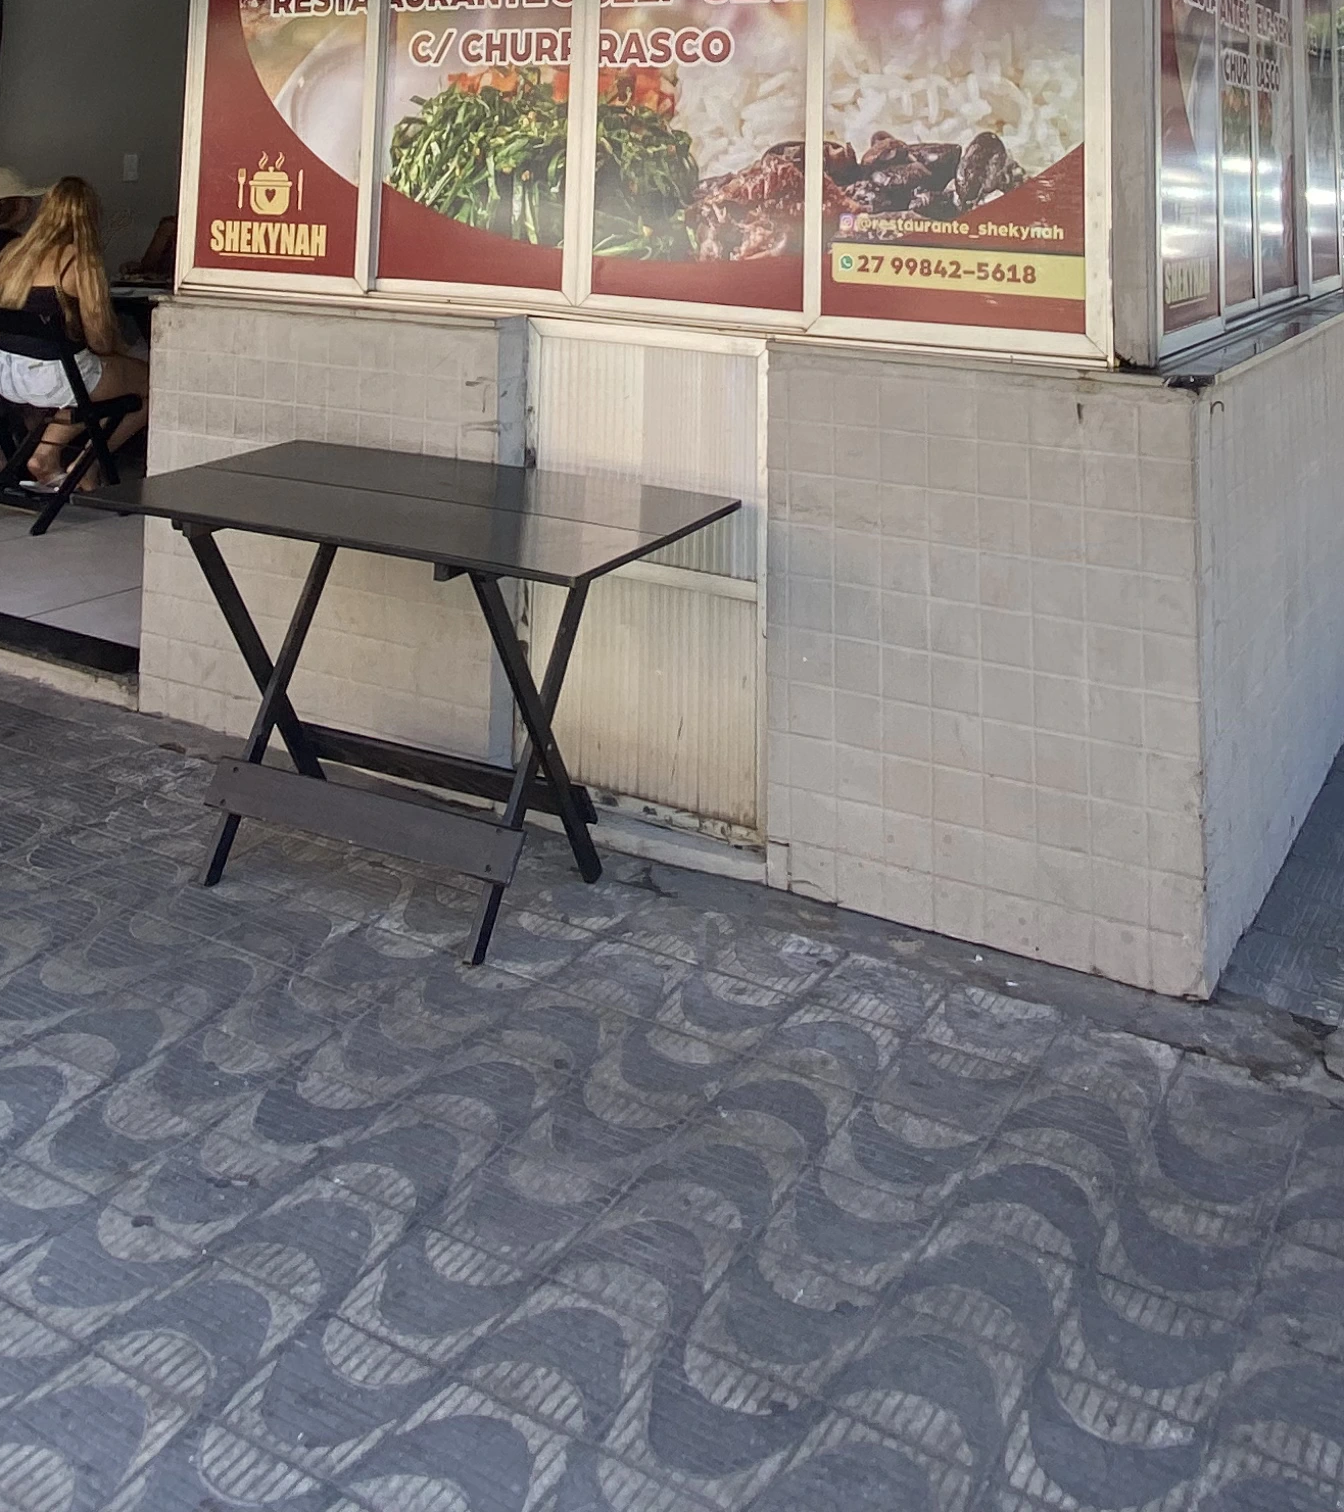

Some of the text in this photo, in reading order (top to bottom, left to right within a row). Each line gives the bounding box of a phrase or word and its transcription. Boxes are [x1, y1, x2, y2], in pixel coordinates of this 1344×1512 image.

[409, 28, 456, 67] C/
[210, 219, 327, 257] SHEKYNAH
[855, 213, 1064, 240] @restaurante_shekynah
[857, 255, 1036, 284] 27 99842-5618
[1165, 257, 1210, 304] SHEKYNAH
